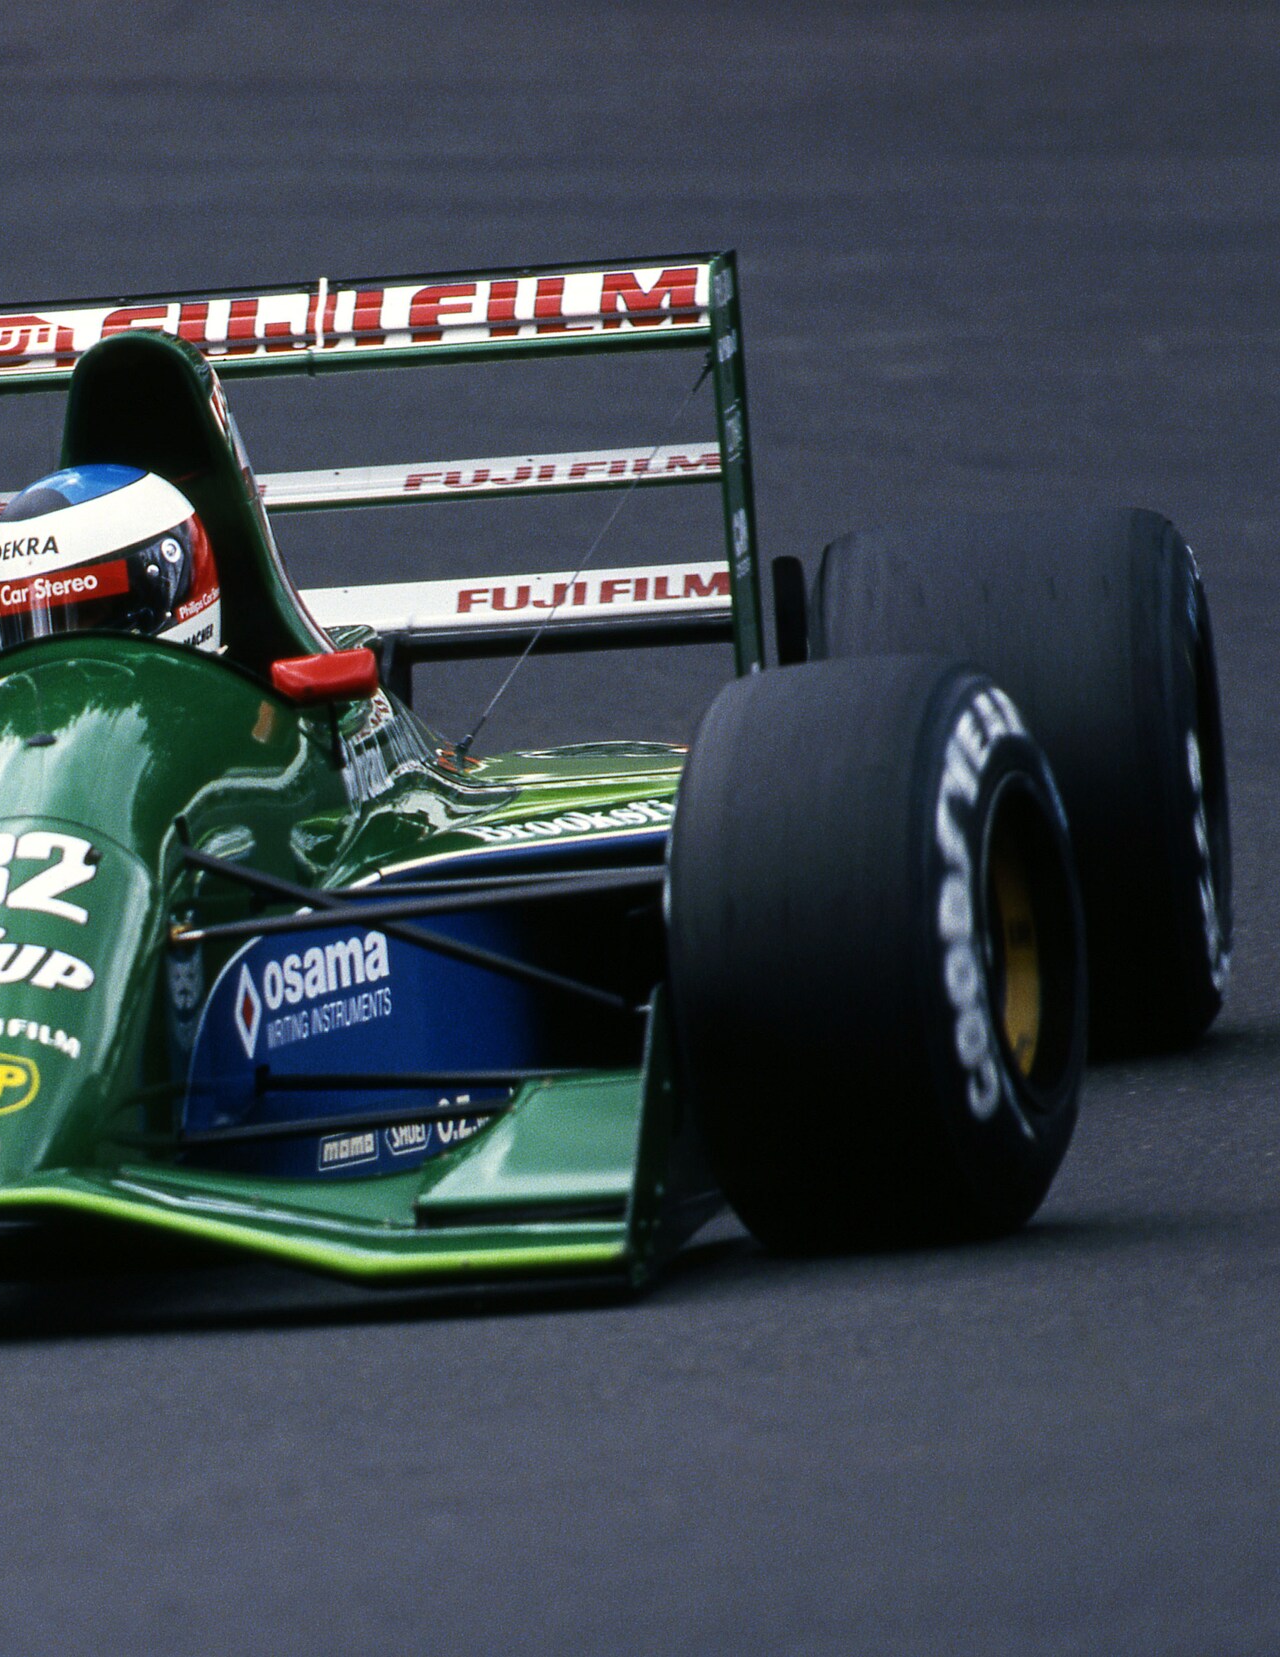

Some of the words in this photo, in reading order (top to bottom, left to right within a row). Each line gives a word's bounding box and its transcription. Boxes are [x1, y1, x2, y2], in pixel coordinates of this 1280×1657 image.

[0, 584, 29, 606] Car
[34, 574, 98, 599] Stereo
[263, 930, 390, 1010] osama
[310, 986, 392, 1036] INSTRUMENTS
